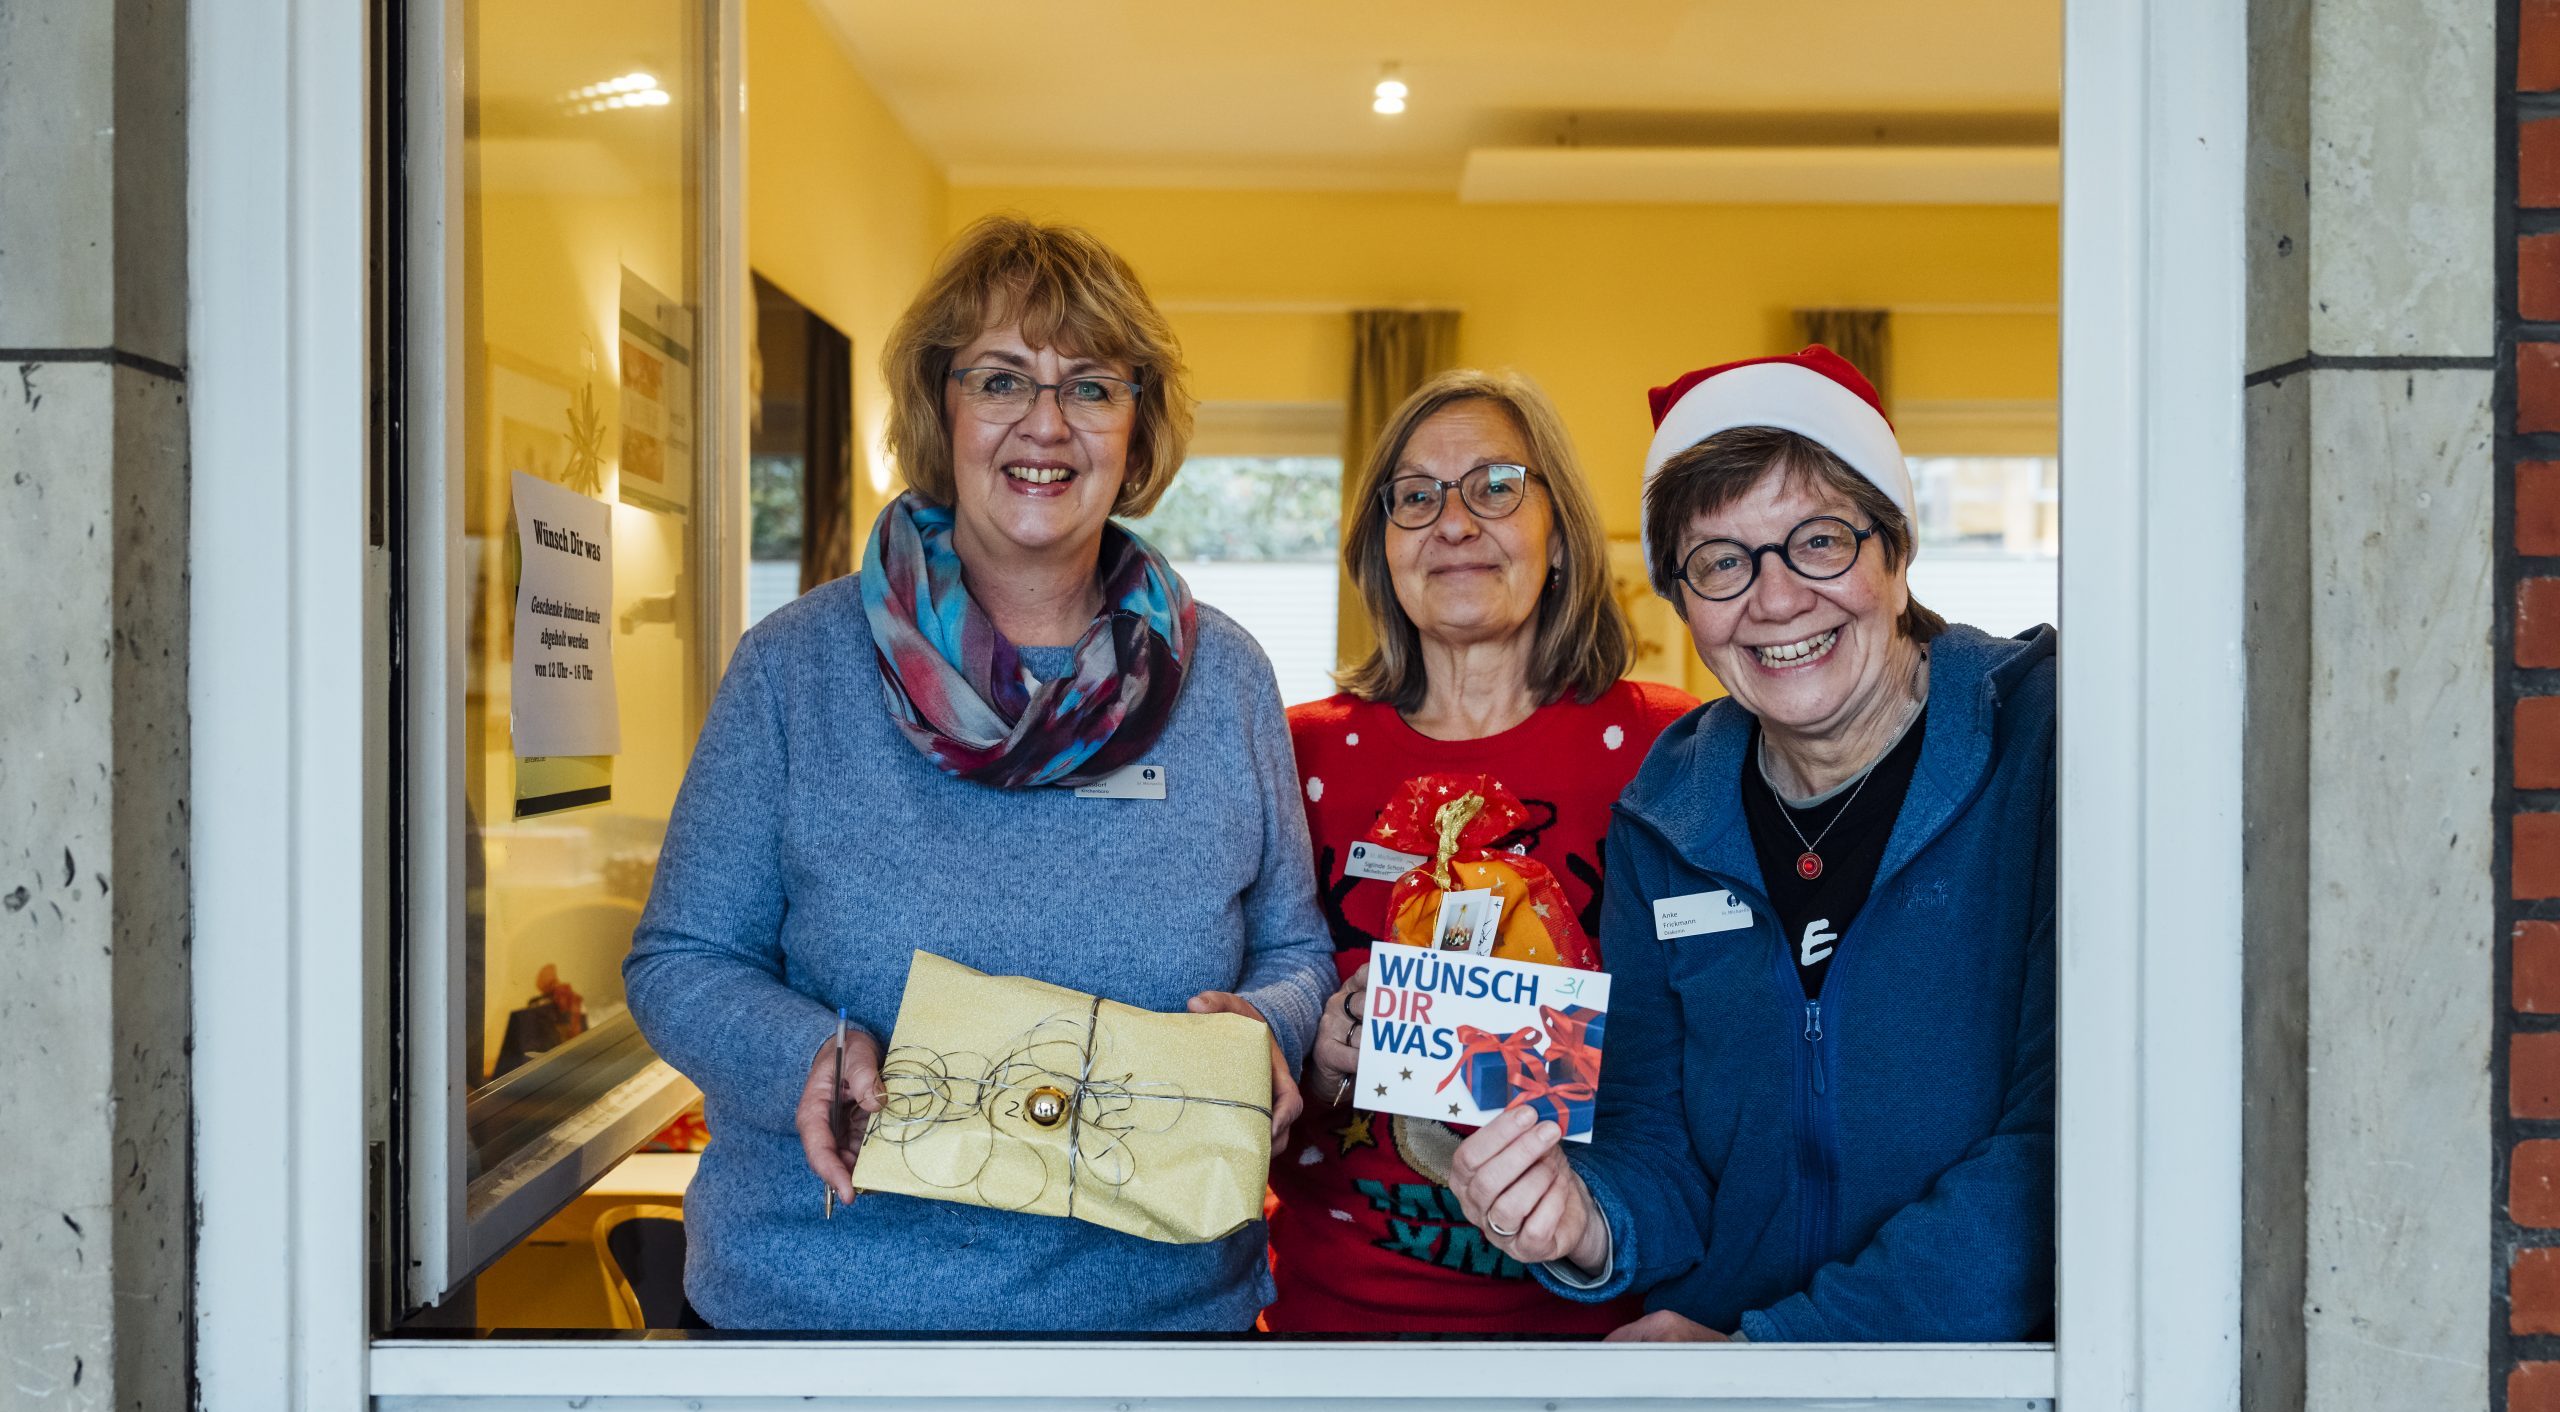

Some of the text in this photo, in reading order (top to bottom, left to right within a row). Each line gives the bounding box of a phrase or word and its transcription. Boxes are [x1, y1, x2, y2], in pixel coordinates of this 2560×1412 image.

[533, 519, 601, 562] Wünsch Dir was
[531, 595, 601, 625] Geschenke können heute
[540, 627, 589, 650] abgeholt werden
[534, 663, 547, 677] von
[548, 662, 556, 678] 12
[556, 661, 569, 679] Uhr
[574, 664, 582, 680] 16
[582, 664, 593, 681] Uhr
[1663, 919, 1697, 929] Frickmann
[1378, 951, 1539, 1007] WÜNSCH
[1554, 976, 1585, 999] 31
[1371, 986, 1434, 1025] DIR
[1371, 1018, 1455, 1061] WAS
